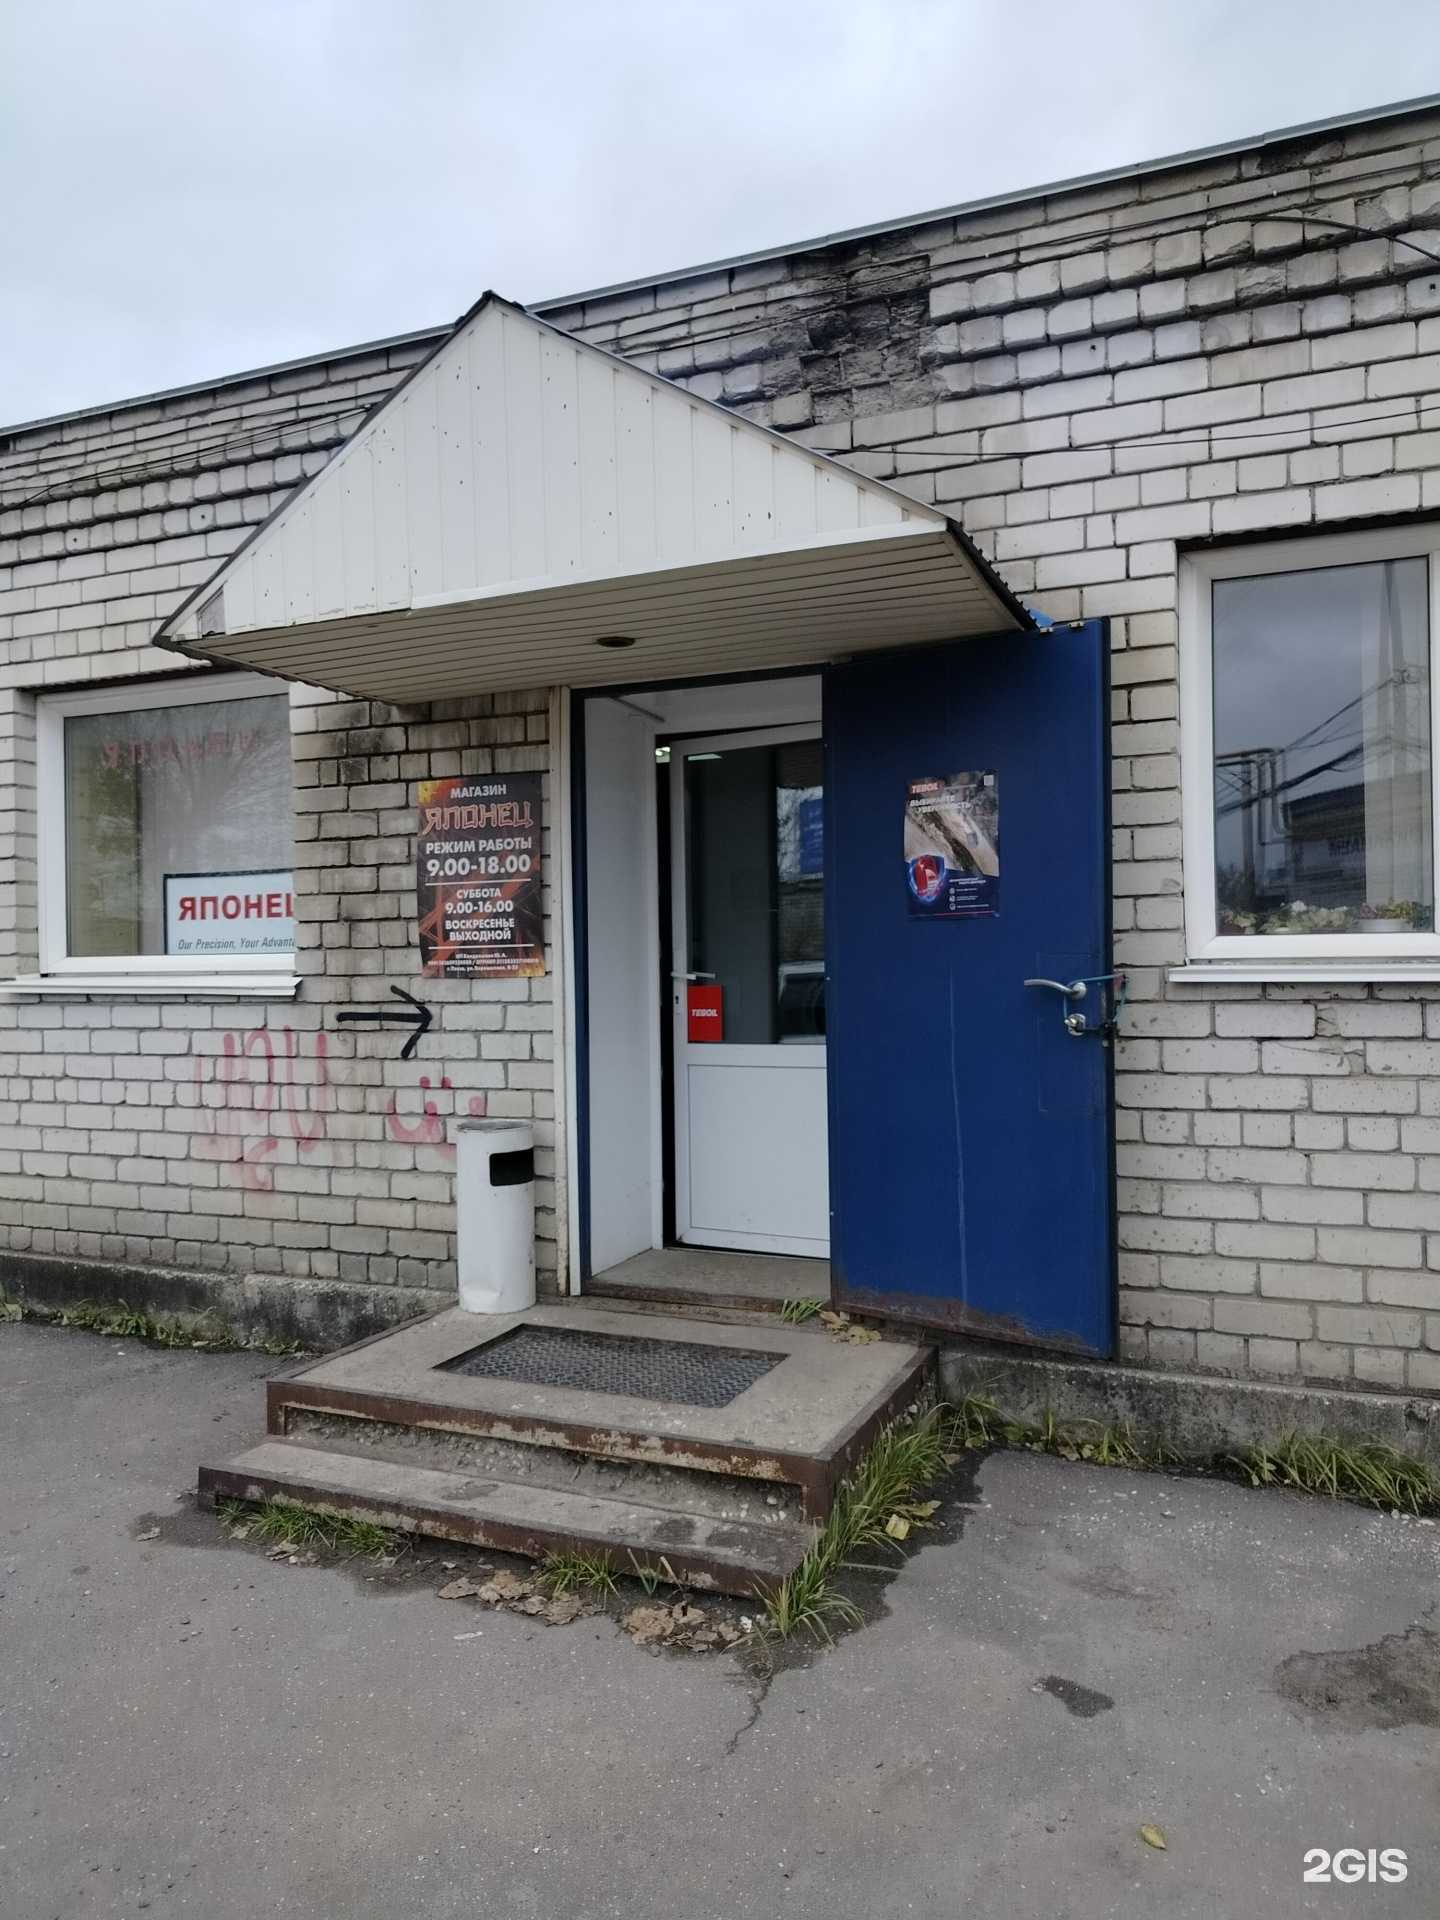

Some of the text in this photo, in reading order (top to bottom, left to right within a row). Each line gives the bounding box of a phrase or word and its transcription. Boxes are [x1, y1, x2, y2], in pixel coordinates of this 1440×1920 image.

[450, 784, 508, 799] МАГАЗИН
[419, 801, 534, 836] ЯПОНЕЦ
[425, 837, 532, 855] РЕЖИМ РАБОТЫ
[426, 855, 532, 877] 9.00-18.00
[456, 888, 502, 900] СУББОТА
[444, 900, 514, 915] 9.00-16.00
[444, 918, 515, 930] ВОСКРЕСЕНЬЕ
[449, 928, 512, 942] ВЫХОДНОЙ
[177, 939, 193, 950] Our
[195, 938, 237, 951] Precision,
[240, 937, 259, 949] Your
